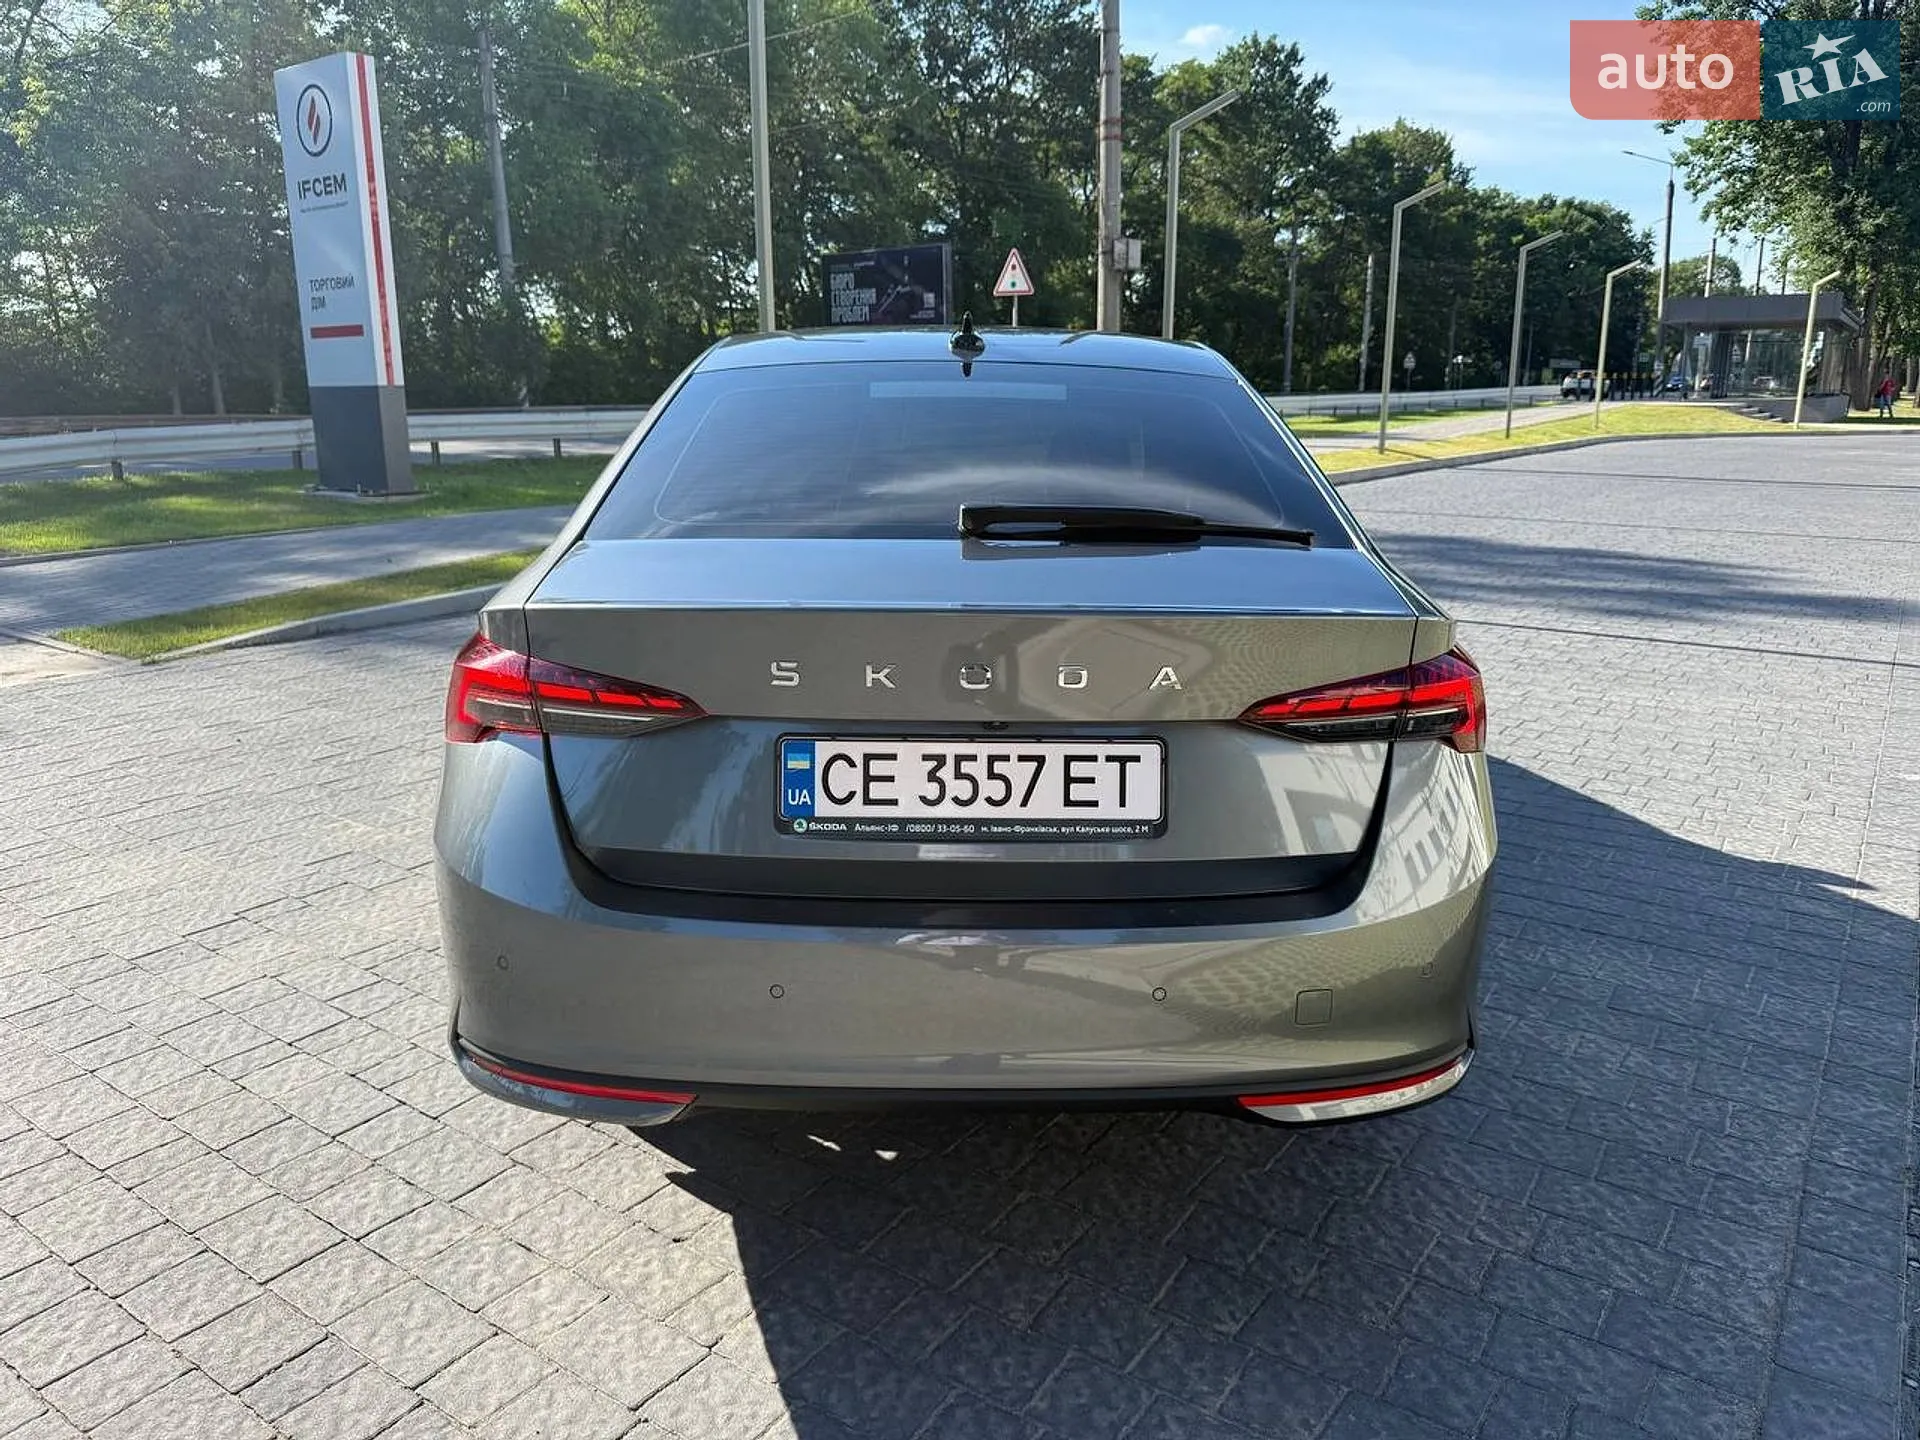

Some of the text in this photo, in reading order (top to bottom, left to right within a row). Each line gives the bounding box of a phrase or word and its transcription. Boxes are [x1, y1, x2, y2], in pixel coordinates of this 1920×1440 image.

[297, 172, 348, 200] IFCEM
[309, 273, 355, 292] ТОРГОВИЙ
[821, 752, 1142, 808] CE 3557 ET
[788, 788, 811, 806] UA
